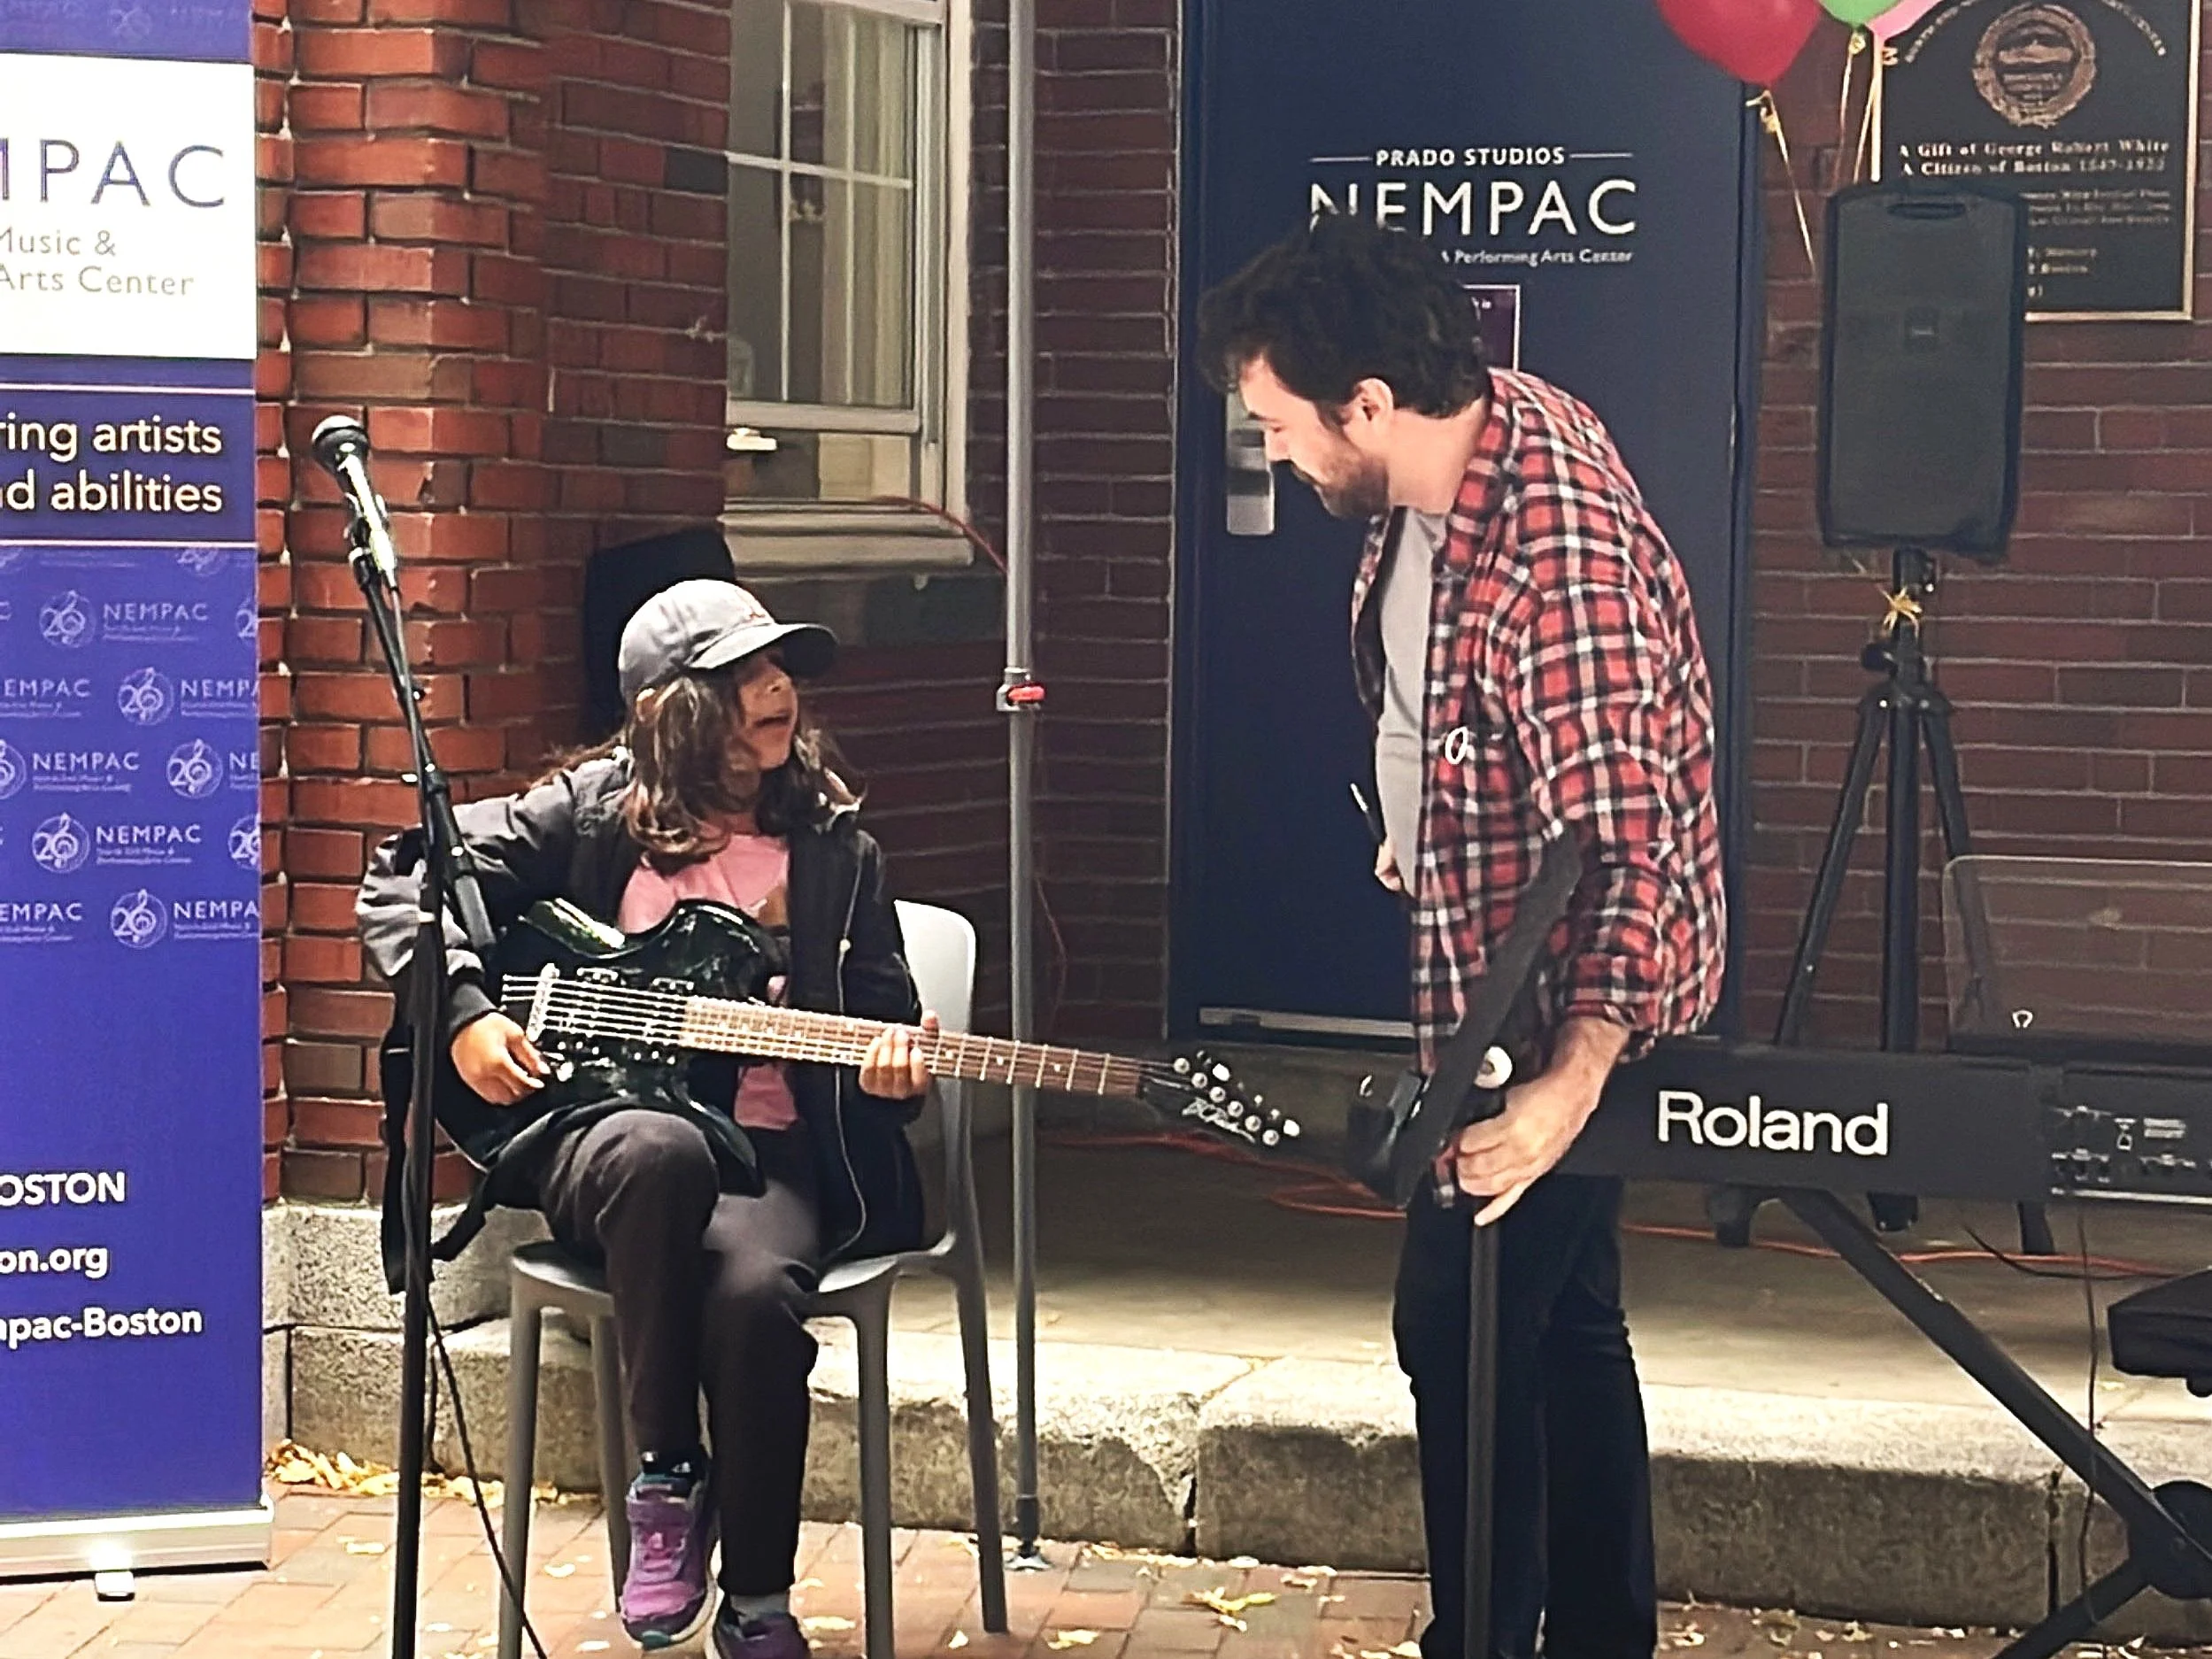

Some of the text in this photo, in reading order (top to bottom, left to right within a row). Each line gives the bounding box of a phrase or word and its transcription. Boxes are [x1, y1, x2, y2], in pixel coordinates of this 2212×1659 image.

[1376, 147, 1566, 166] PRADO STUDIOS
[1917, 143, 1953, 158] Gift
[1959, 143, 1977, 157] of
[2118, 139, 2170, 153] White
[0, 137, 225, 209] PAC
[1920, 161, 1983, 176] Citizen
[1988, 159, 2007, 174] of
[2013, 159, 2072, 174] Boston
[1308, 179, 1638, 237] NEMPAC
[94, 230, 116, 257] &
[1454, 249, 1538, 267] Performing
[1540, 249, 1575, 264] Arts
[1579, 248, 1635, 264] Center
[79, 265, 195, 296] Center
[92, 414, 223, 454] artists
[50, 469, 223, 513] abilities
[104, 603, 208, 621] NEMPAC
[32, 751, 140, 771] NEMPAC
[96, 823, 202, 845] NEMPAC
[1657, 1090, 1889, 1156] Roland
[0, 1307, 203, 1350] pac-Boston
